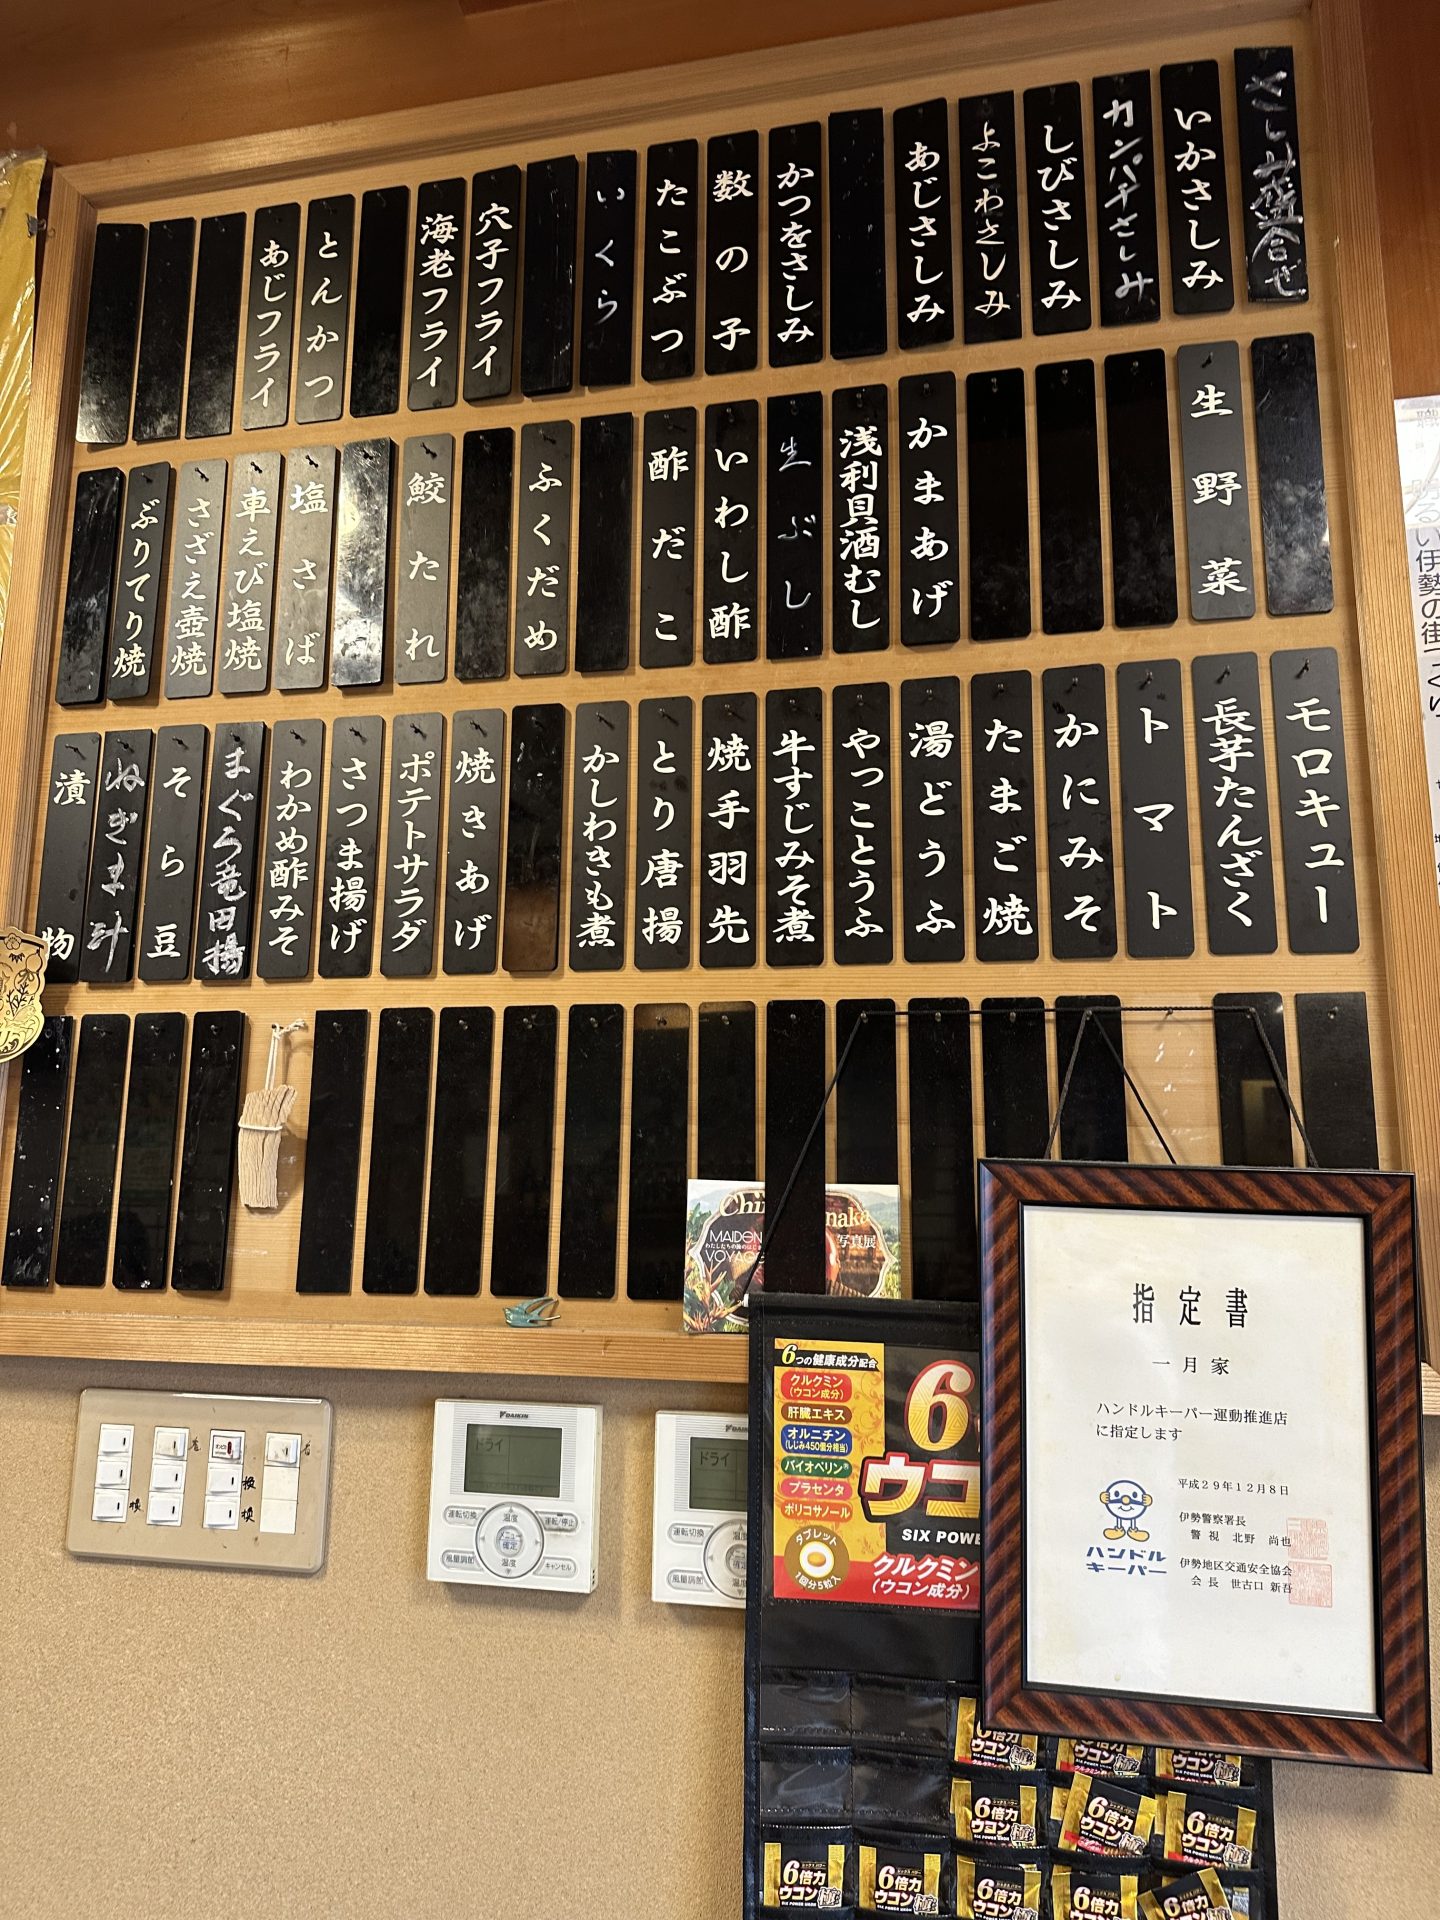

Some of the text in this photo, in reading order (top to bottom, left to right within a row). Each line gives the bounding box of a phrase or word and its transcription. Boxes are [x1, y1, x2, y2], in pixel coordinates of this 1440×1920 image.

[1102, 98, 1154, 302] カンパチさしみ
[1174, 107, 1223, 289] いかさしみ
[972, 121, 1010, 317] よこわさしみ
[1037, 125, 1082, 309] しびさしみ
[904, 141, 945, 323] あじさしみ
[594, 187, 628, 324] いくら
[650, 179, 688, 353] たこぶつ
[712, 169, 754, 351] 数の子
[776, 162, 815, 343] かつをさしみ
[416, 213, 459, 387] 海老フライ
[471, 202, 513, 376] 穴子フライ
[250, 239, 289, 408] あじフライ
[304, 231, 343, 398] とんかつ
[1190, 384, 1247, 596] 生野菜
[777, 436, 816, 609] 生ぶし
[839, 425, 883, 629] 浅利貝酒むし
[907, 417, 954, 618] かまあげ
[523, 462, 563, 651] ふくだめ
[648, 446, 689, 641] 酢だこ
[708, 448, 751, 639] いわし酢
[222, 486, 271, 671] 車えび塩焼
[284, 483, 329, 666] 塩さば
[405, 471, 447, 661] 鮫たれ
[111, 498, 160, 678] ぶりてり焼
[1053, 713, 1104, 932] かにみそ
[1133, 707, 1178, 930] トマト
[1201, 697, 1263, 927] 長芋たんざく
[1285, 697, 1345, 924] モロキュー
[706, 733, 752, 944] 焼手羽先
[772, 729, 816, 943] 牛すじみそ煮
[908, 720, 956, 934] 湯どうふ
[982, 718, 1034, 936] たまご焼
[328, 757, 368, 954] さつま揚げ
[391, 750, 435, 952] ポテトサラダ
[454, 746, 496, 950] 焼きあげ
[575, 744, 620, 948] かしわきも煮
[640, 740, 684, 945] とり唐揚
[42, 768, 92, 961] 漬物
[146, 766, 192, 958] そら豆
[202, 746, 252, 975] まぐろ竜田揚
[268, 760, 312, 956] わかめ酢みそ
[720, 1190, 765, 1217] Chi
[837, 1234, 876, 1249] 写真展
[1132, 1282, 1249, 1328] 指定書
[781, 1344, 878, 1369] 6つの健康成分配合
[1152, 1356, 1230, 1376] 一月家
[789, 1387, 844, 1401] (ウコン成分)
[790, 1373, 844, 1388] クルクミン
[505, 1412, 529, 1420] DAIKIN
[787, 1406, 846, 1421] 肝臓エキス
[907, 1361, 979, 1451] 6
[1096, 1401, 1288, 1427] ハンドルキーパー運動推進店
[475, 1436, 504, 1453] ドライ
[787, 1427, 846, 1442] オルニチン
[1096, 1423, 1182, 1442] に指定します
[700, 1450, 730, 1468] ドライ
[788, 1481, 845, 1496] プラセンタ
[448, 1509, 478, 1520] 運転切換
[504, 1513, 518, 1523] 温度
[784, 1503, 851, 1519] ポリコサノール
[1179, 1511, 1247, 1527] 伊勢警察署長
[500, 1531, 522, 1540] メニュー
[502, 1541, 518, 1551] 確定
[673, 1527, 704, 1538] 運転切換
[795, 1528, 838, 1546] タブレット
[902, 1528, 930, 1543] SIX
[1232, 1532, 1256, 1545] 北野
[1268, 1535, 1292, 1548] 尚也
[501, 1557, 517, 1568] 温度
[545, 1562, 572, 1572] キャンセル
[873, 1553, 979, 1582] クルクミン
[1086, 1546, 1168, 1562] ハンドル
[1179, 1557, 1293, 1578] 伊勢地区交通安全協会
[1086, 1562, 1168, 1577] キーパー
[872, 1579, 971, 1601] (ウコン成分)
[1191, 1575, 1293, 1594] 会長 世古口 新吾
[971, 1739, 1011, 1756] ウコン
[1074, 1744, 1114, 1764] ウコン
[1173, 1754, 1214, 1772] ウコン
[974, 1797, 1019, 1822] 6倍力
[1088, 1797, 1133, 1831] 6倍力
[971, 1819, 1011, 1835] ウコン
[1081, 1816, 1122, 1841] ウコン
[1187, 1811, 1234, 1842] 6倍力
[1182, 1833, 1224, 1854] ウコン
[783, 1860, 826, 1885] 6倍力
[879, 1866, 922, 1892] 6倍力
[780, 1886, 818, 1901] ウコン
[875, 1890, 914, 1906] ウコン
[977, 1879, 1022, 1905] 6倍力
[1074, 1886, 1119, 1915] 6倍力
[1163, 1895, 1208, 1917] 6倍力
[973, 1900, 1013, 1917] ウコン
